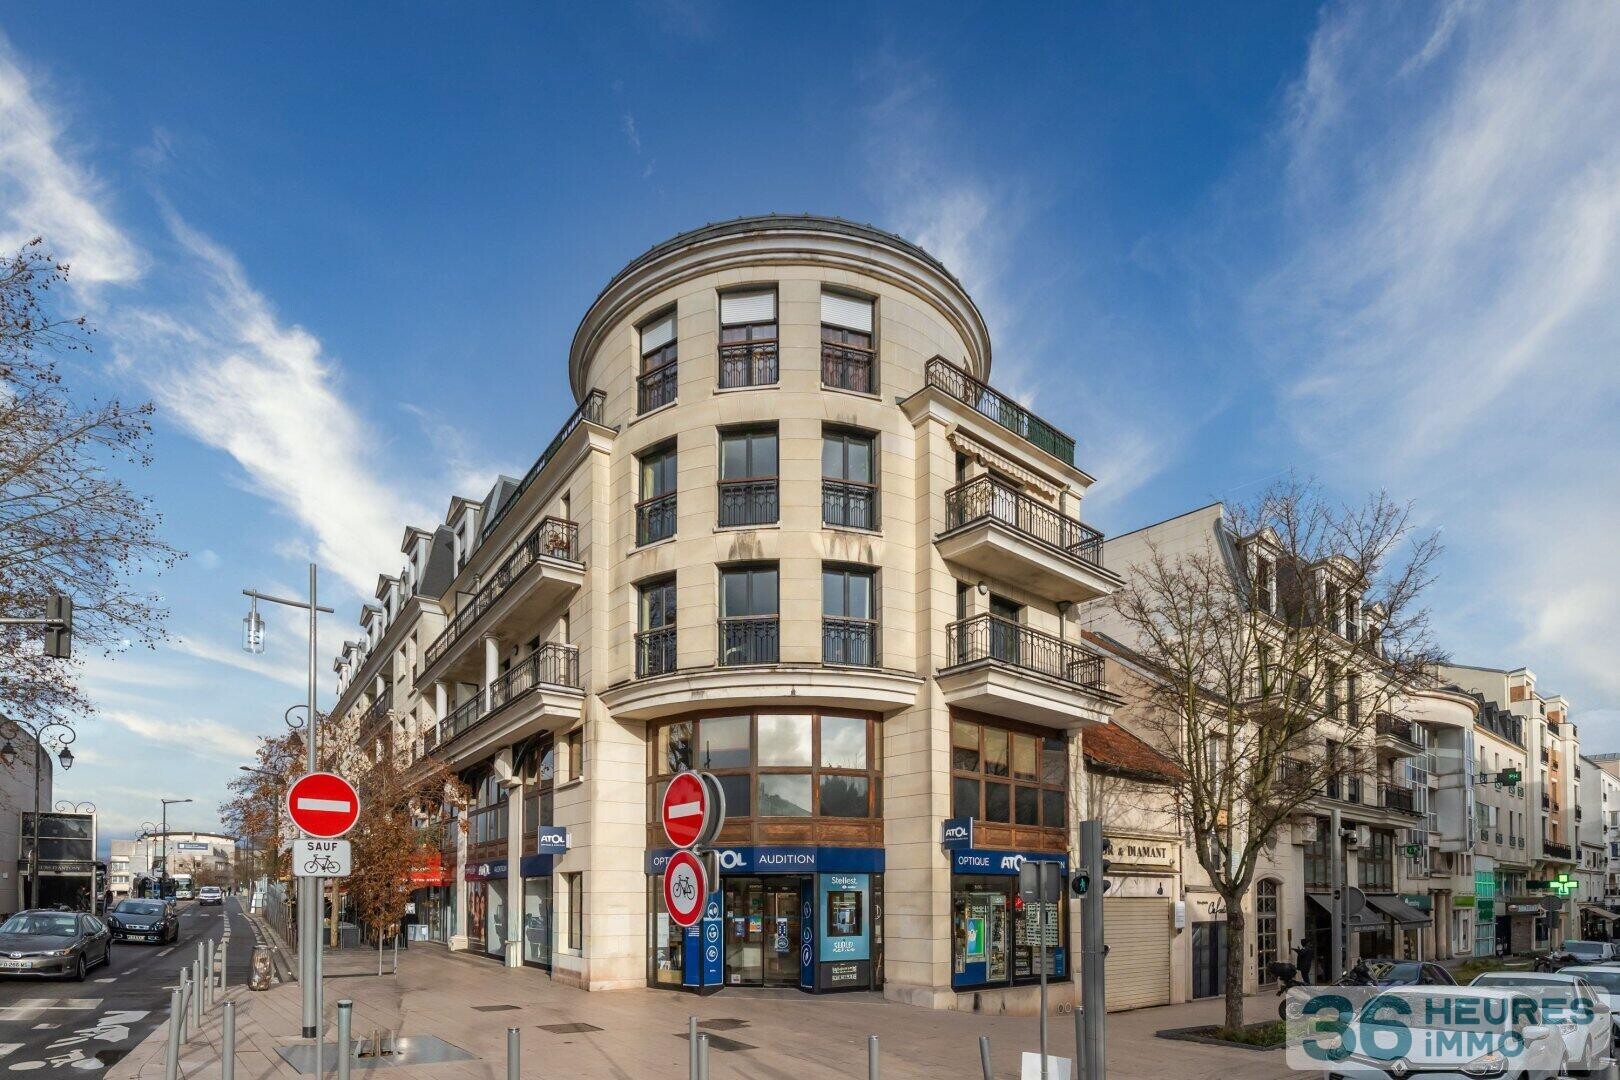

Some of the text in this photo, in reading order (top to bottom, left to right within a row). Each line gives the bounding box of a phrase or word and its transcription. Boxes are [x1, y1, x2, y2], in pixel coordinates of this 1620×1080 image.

[945, 826, 968, 837] ATOL
[541, 834, 565, 844] ATOL
[307, 841, 338, 851] SAUF
[1118, 848, 1123, 856] &
[1127, 845, 1167, 859] DIAMANT
[759, 854, 815, 864] AUDITION
[958, 856, 990, 867] OPTIQUE
